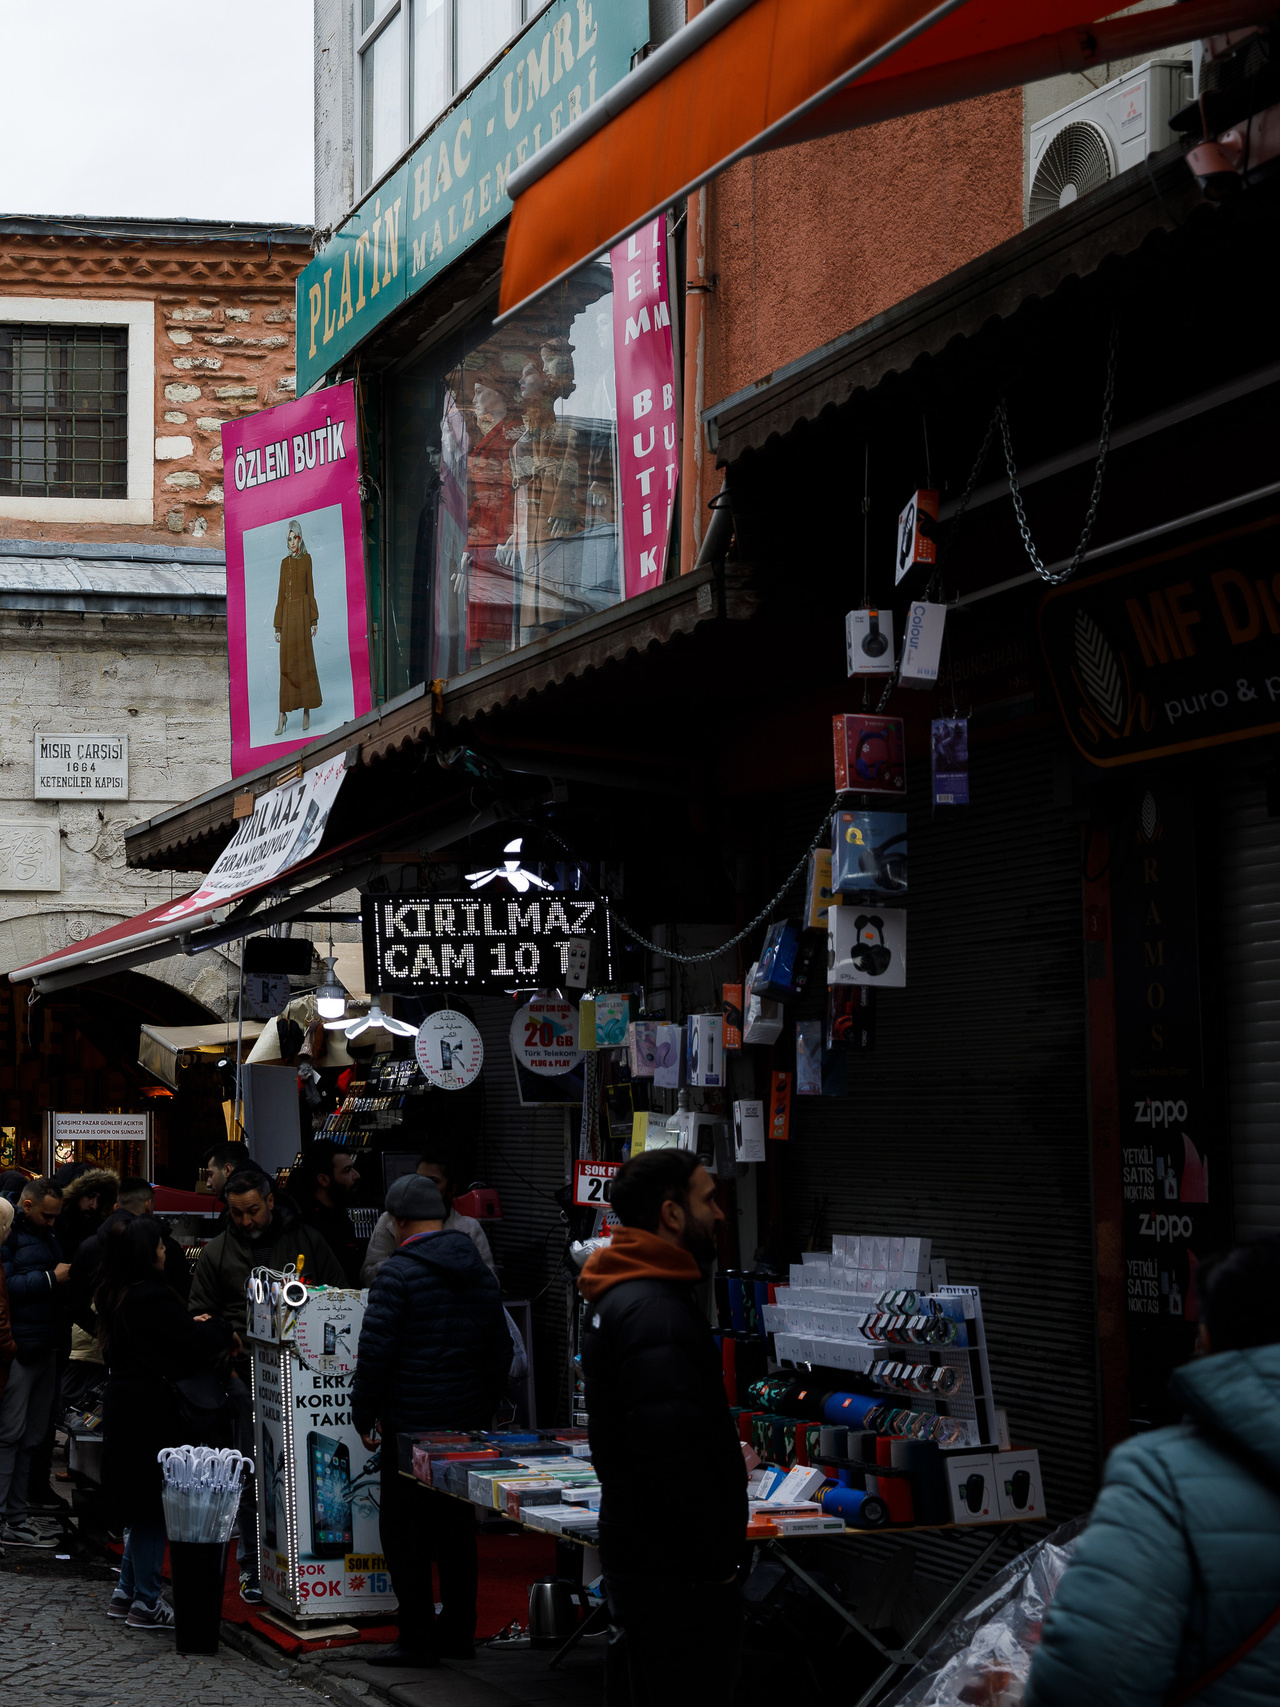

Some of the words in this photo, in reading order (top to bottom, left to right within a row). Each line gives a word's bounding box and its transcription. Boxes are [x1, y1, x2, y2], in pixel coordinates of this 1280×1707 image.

[308, 196, 402, 360] PLATİN
[412, 118, 472, 221] HAC
[234, 439, 291, 492] ÖZLEM
[294, 416, 347, 475] BUTİK
[631, 388, 659, 579] BUTİK
[661, 382, 677, 572] BUTİ
[909, 605, 926, 650] Colour
[1124, 580, 1203, 669] MF
[1163, 688, 1229, 726] puro
[1235, 677, 1259, 702] &
[40, 743, 72, 760] MISIR
[77, 743, 123, 760] ÇARŞISI
[65, 762, 97, 773] 1664
[40, 776, 92, 788] KETENCİLER
[95, 776, 124, 788] KAPISI
[384, 901, 596, 938] KIRILMAZ
[384, 942, 476, 978] CAM
[489, 942, 541, 977] 10
[552, 940, 572, 975] T
[1142, 856, 1167, 1052] RAMOS
[545, 1004, 556, 1012] SIM
[524, 1022, 554, 1048] 20
[555, 1035, 574, 1047] GB
[524, 1049, 542, 1057] Türk
[543, 1049, 577, 1057] Telekom
[530, 1059, 547, 1067] PLUG
[554, 1059, 571, 1067] PLAY
[1133, 1096, 1188, 1129] zippo
[1122, 1144, 1154, 1165] YETKİLİ
[584, 1165, 607, 1176] ŞOK
[1122, 1166, 1155, 1184] SATIŞ
[1123, 1185, 1155, 1200] NOKTASI
[1138, 1208, 1193, 1243] zippo
[1126, 1257, 1158, 1278] YETKİLİ
[1127, 1278, 1159, 1298] SATIŞ
[1127, 1297, 1159, 1314] NOKTASI
[339, 1363, 350, 1371] TL
[313, 1375, 355, 1389] EKRA
[295, 1393, 352, 1409] KORUY
[310, 1412, 351, 1427] TAKI
[299, 1564, 325, 1578] ŞOK
[348, 1557, 370, 1573] ŞOK
[300, 1580, 342, 1601] ŞOK
[367, 1573, 387, 1593] 15
